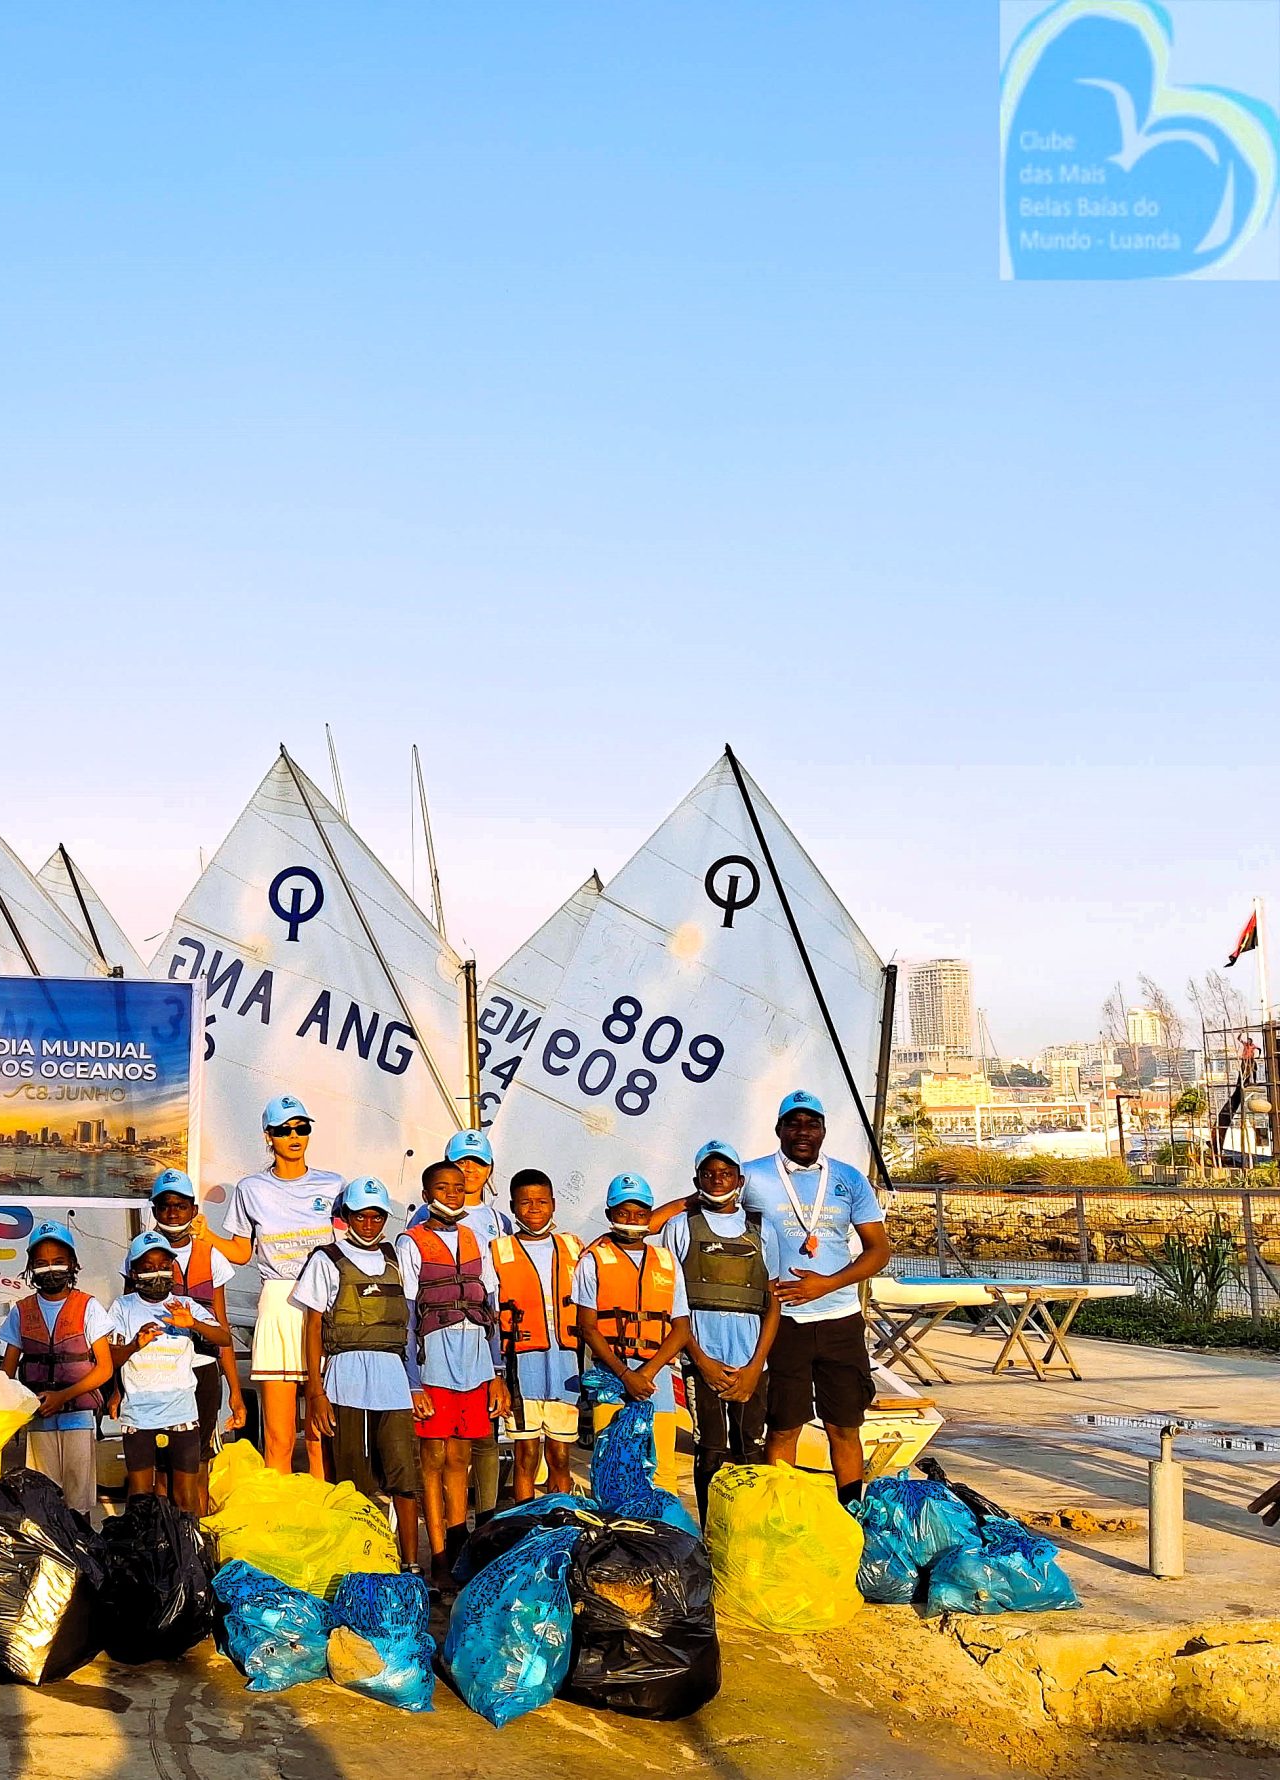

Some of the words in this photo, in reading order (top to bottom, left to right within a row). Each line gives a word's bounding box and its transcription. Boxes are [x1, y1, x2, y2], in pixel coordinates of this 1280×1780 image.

[295, 989, 420, 1076] ANG
[601, 995, 725, 1084] 809
[41, 1039, 152, 1060] MUNDIAL
[40, 1061, 158, 1082] OCEANOS
[54, 1085, 126, 1103] JUNHO
